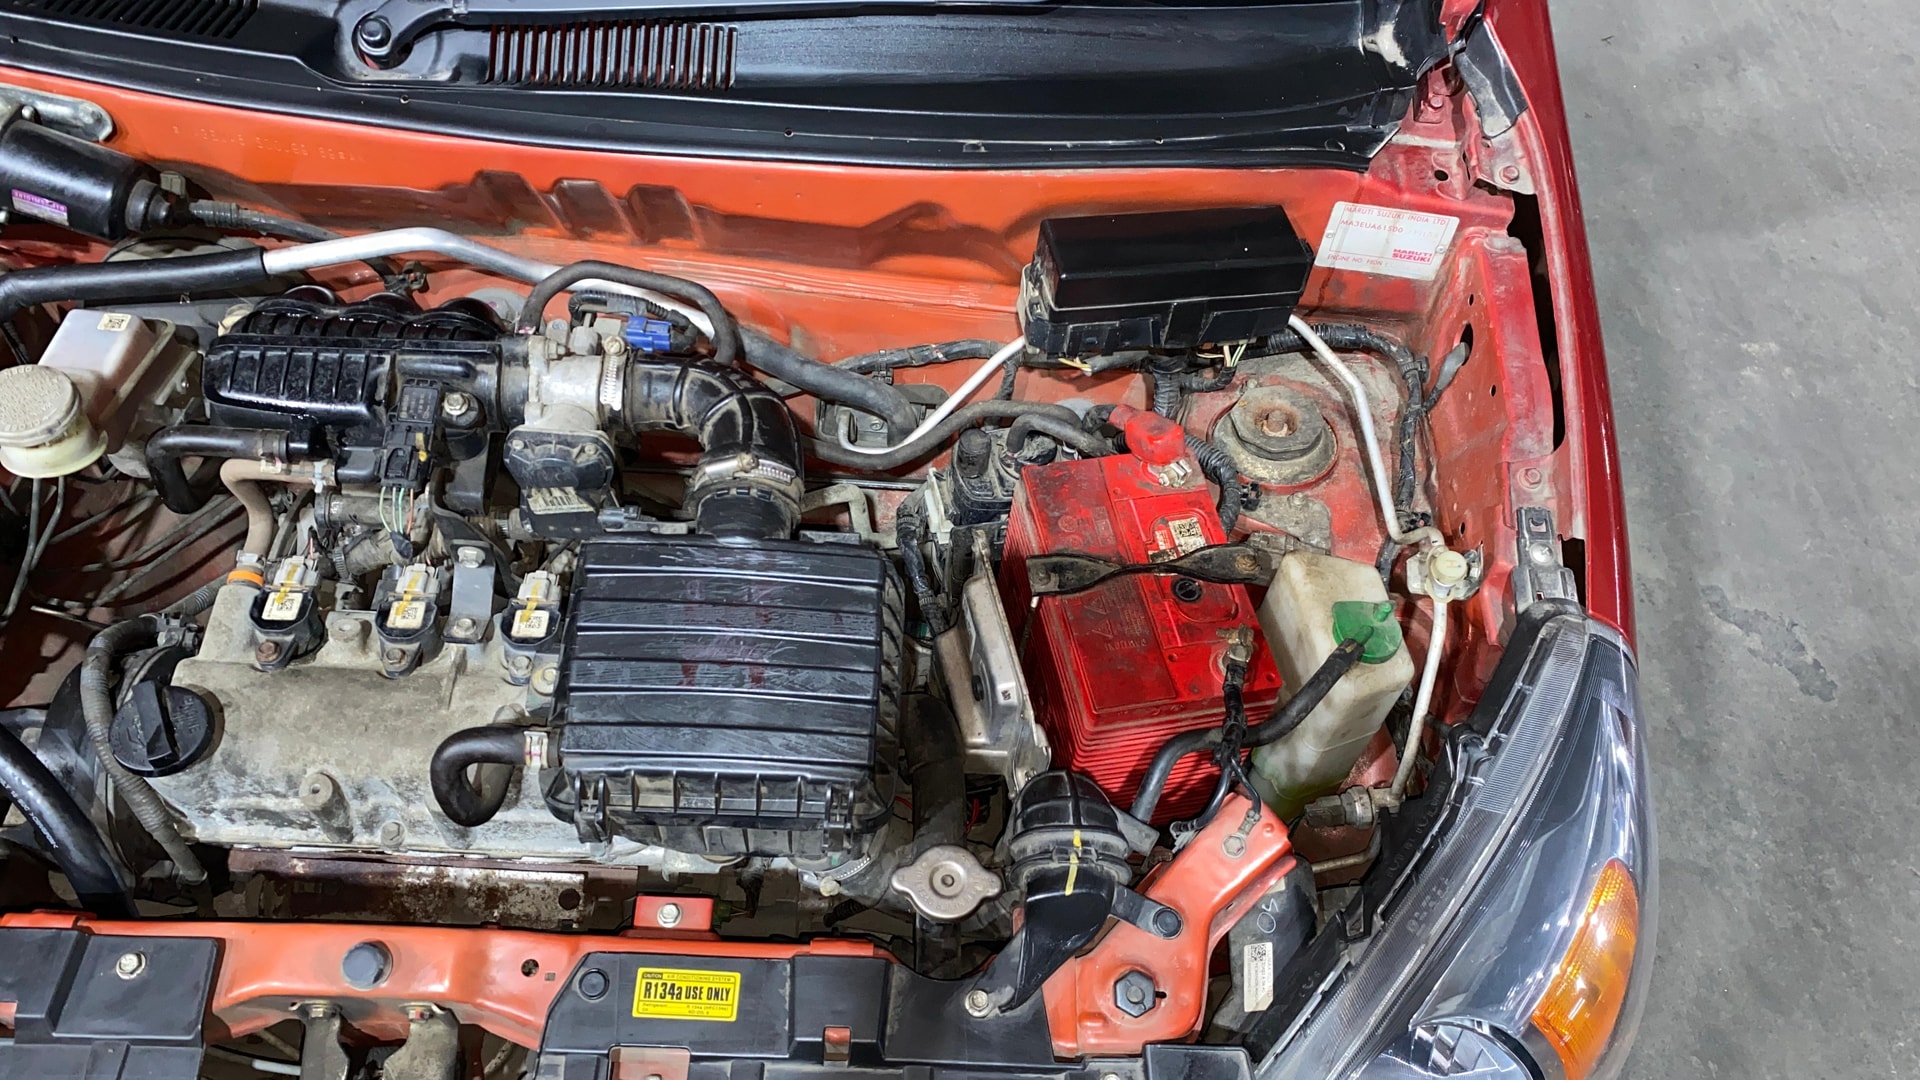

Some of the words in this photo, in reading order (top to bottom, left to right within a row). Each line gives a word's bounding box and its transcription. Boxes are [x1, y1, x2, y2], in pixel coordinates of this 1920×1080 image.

[1377, 211, 1405, 221] SUZUKI
[1408, 214, 1429, 224] INDIA
[1392, 252, 1431, 263] SUZUKI
[1393, 248, 1433, 258] MARUTI
[644, 981, 683, 1001] R134a
[685, 985, 704, 1000] USE
[706, 986, 731, 1002] ONLY
